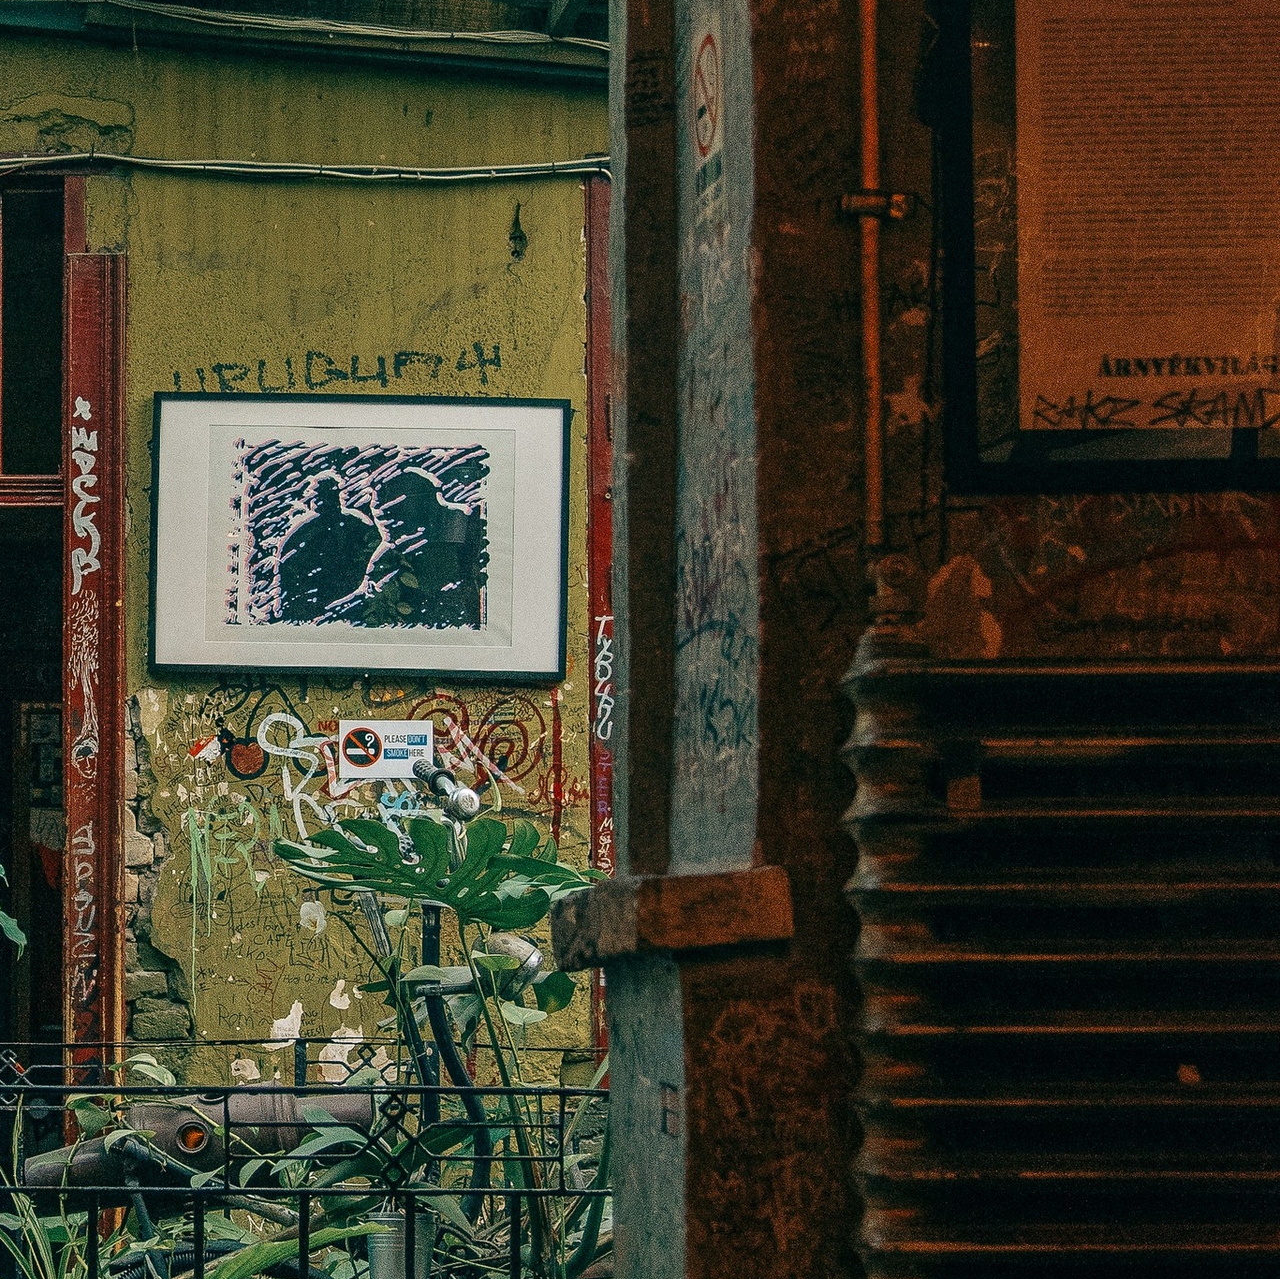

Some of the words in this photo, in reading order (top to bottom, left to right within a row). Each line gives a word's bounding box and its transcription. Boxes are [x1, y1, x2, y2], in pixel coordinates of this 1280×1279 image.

[384, 734, 407, 744] PLEASE
[408, 734, 426, 744] DON'T
[386, 748, 408, 758] SMOKE
[409, 748, 425, 758] HERE
